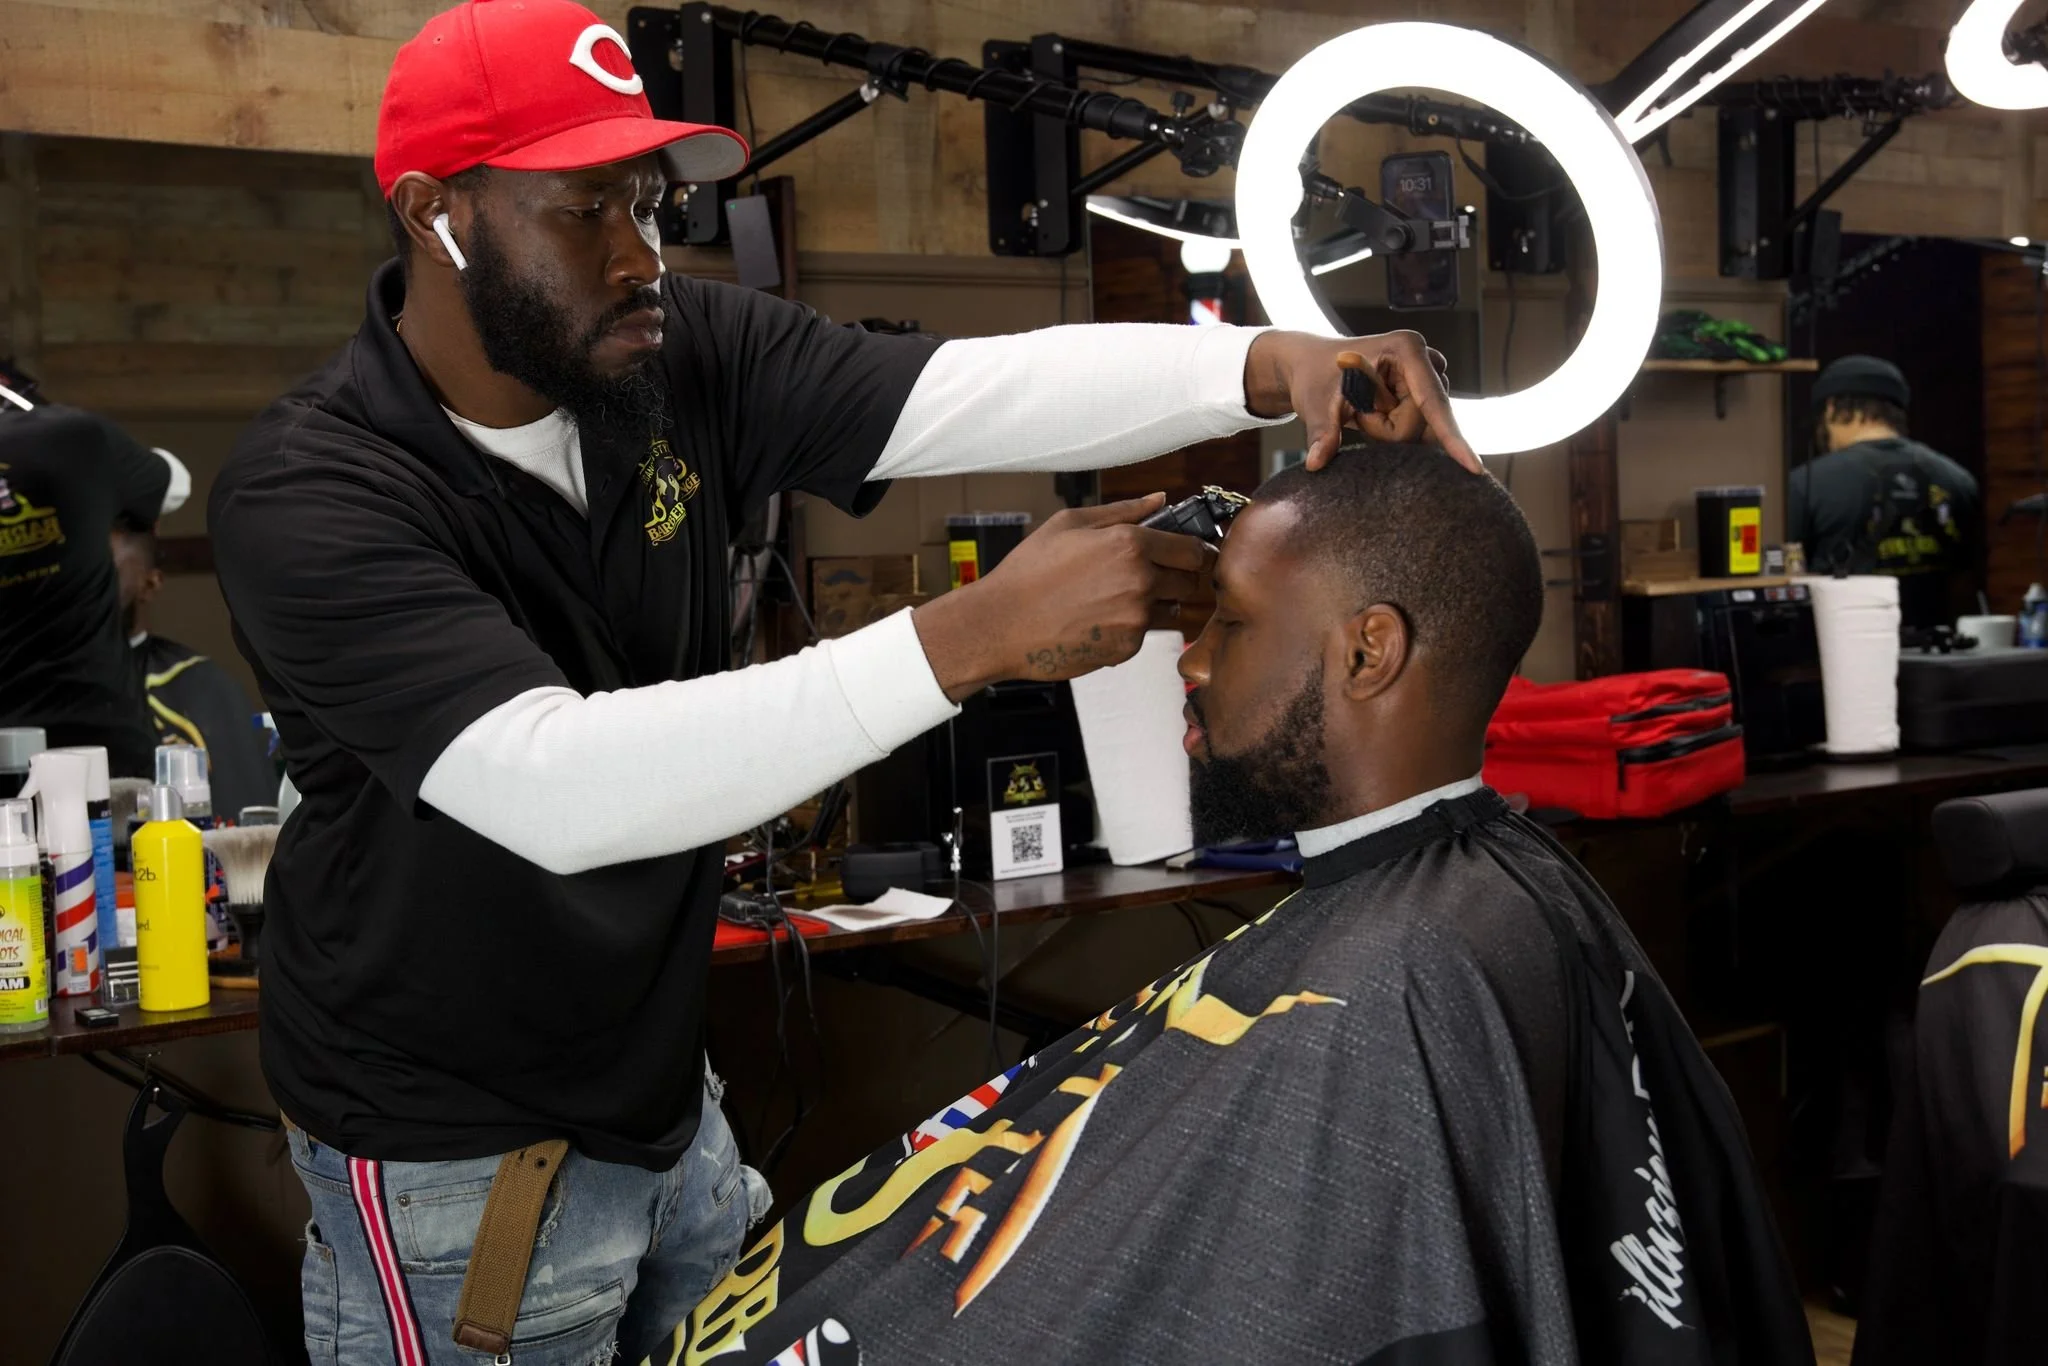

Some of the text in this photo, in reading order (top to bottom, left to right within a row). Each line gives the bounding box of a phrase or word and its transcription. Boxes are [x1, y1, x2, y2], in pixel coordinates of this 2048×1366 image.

[569, 23, 644, 95] C
[1400, 177, 1432, 192] 10:31
[647, 502, 687, 541] BARBER
